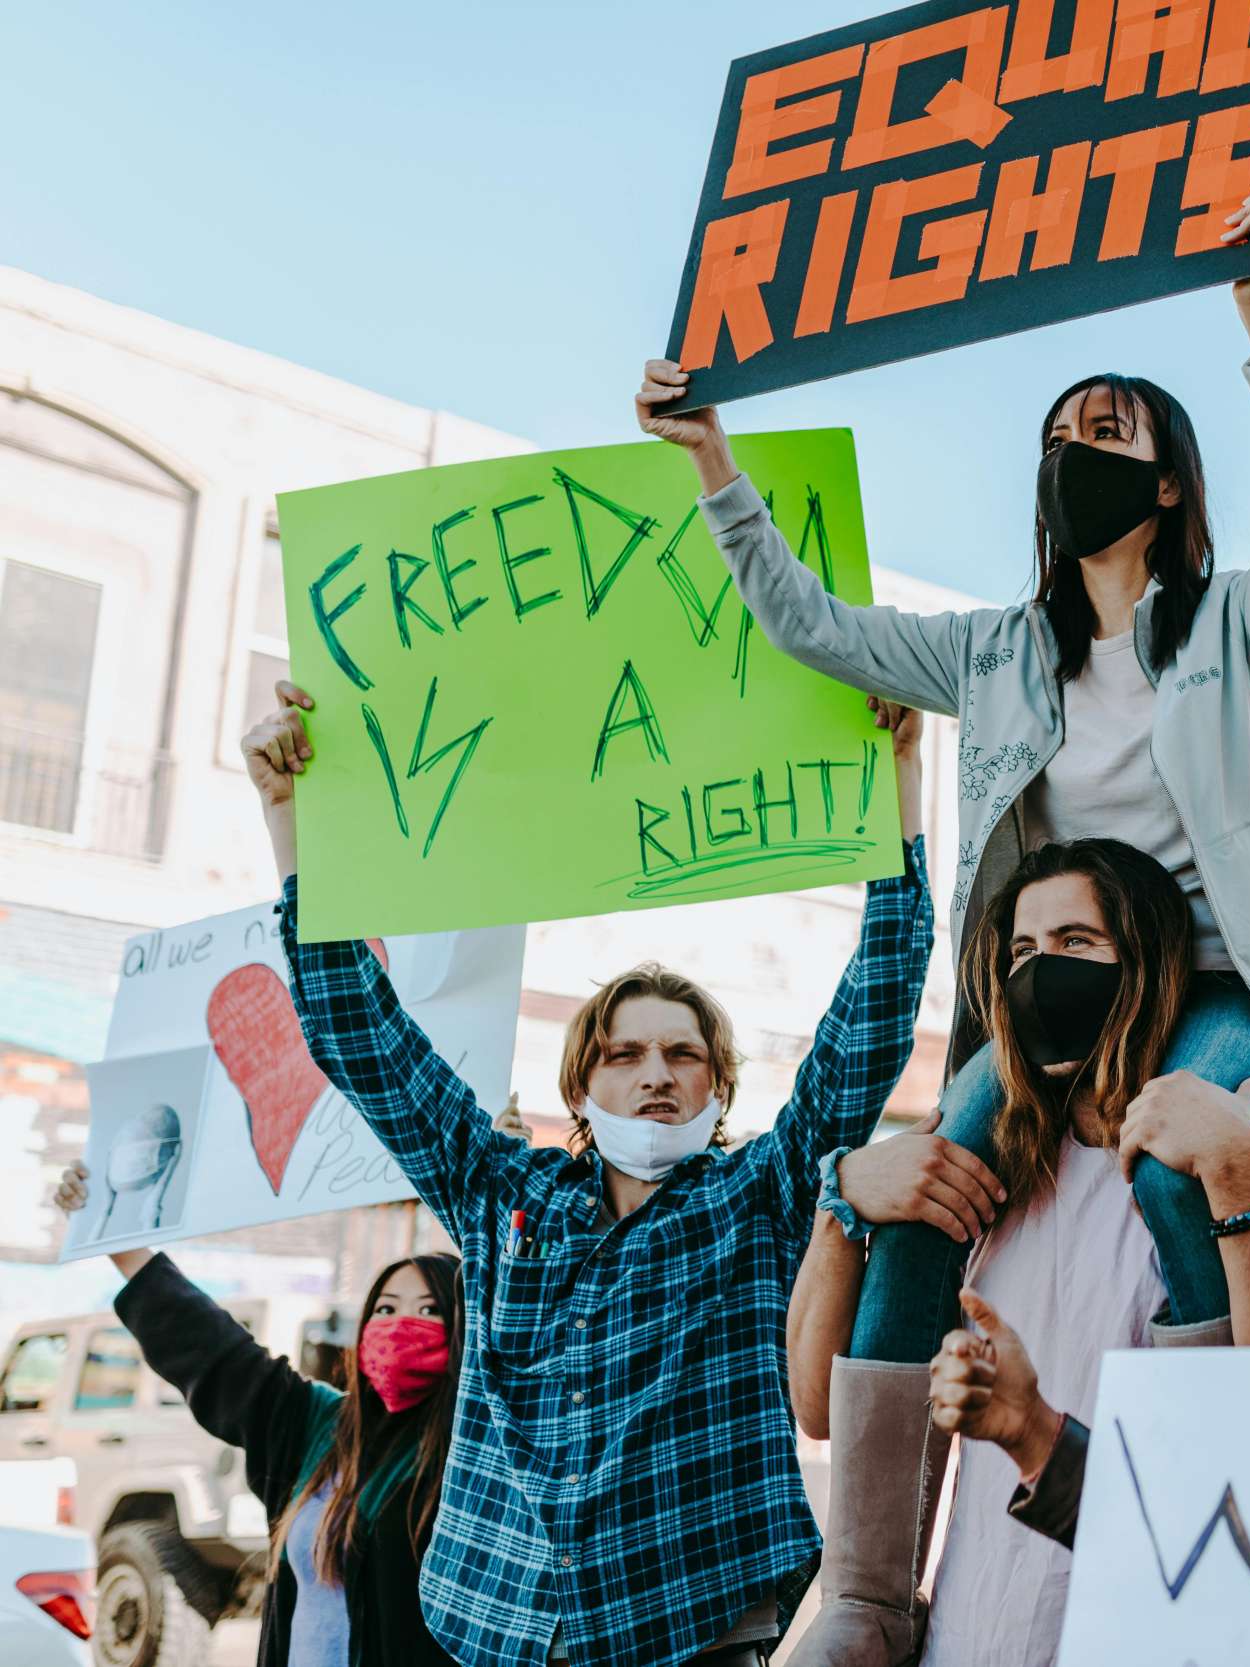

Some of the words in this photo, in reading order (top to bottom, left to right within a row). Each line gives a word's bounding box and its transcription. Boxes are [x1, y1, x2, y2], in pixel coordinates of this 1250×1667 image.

[590, 659, 671, 783] A
[634, 740, 878, 876] RIGHT!
[123, 932, 163, 978] all
[166, 932, 224, 969] we
